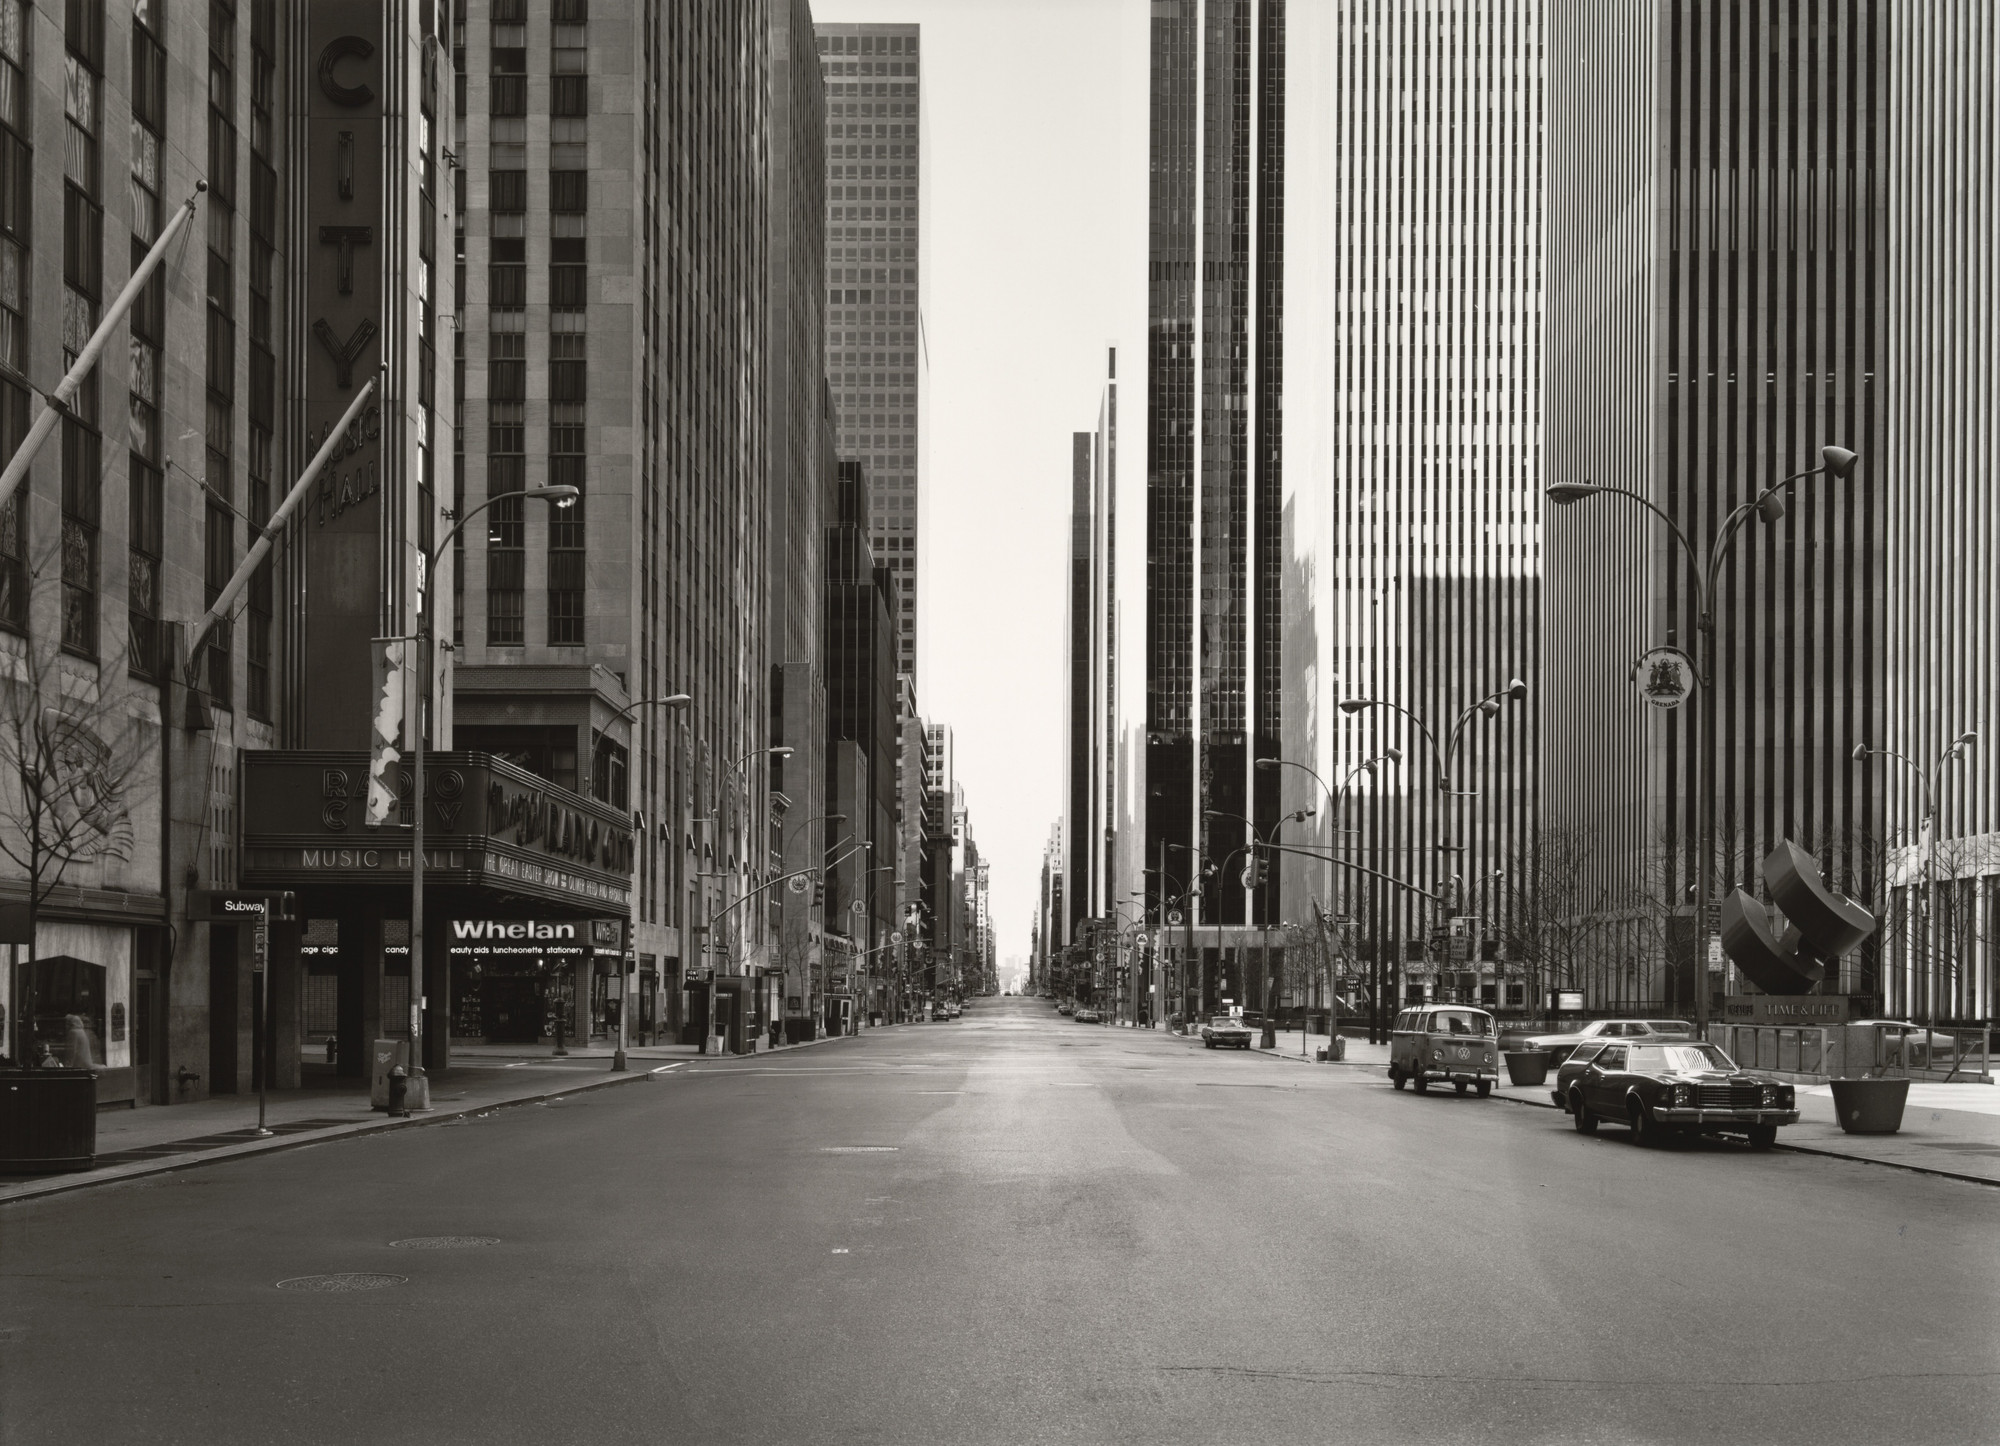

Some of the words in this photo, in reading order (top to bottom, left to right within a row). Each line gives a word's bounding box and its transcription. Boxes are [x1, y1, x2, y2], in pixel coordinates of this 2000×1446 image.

[312, 35, 378, 389] CITY
[318, 460, 380, 527] HALL
[1651, 699, 1680, 708] GRENADA
[322, 800, 463, 830] CTY
[303, 850, 379, 868] MUSIC
[500, 856, 519, 876] GREAT
[521, 862, 543, 882] EASTER
[224, 900, 265, 913] Subway
[452, 920, 575, 939] Whelan
[385, 945, 409, 955] candy
[450, 946, 472, 955] eauty
[473, 945, 489, 954] aids
[492, 945, 543, 954] luncheonette
[546, 945, 583, 956] stationery
[1766, 1004, 1798, 1016] TIME
[1800, 1004, 1809, 1016] &
[1811, 1004, 1840, 1016] LIFE
[1457, 1047, 1471, 1060] VW
